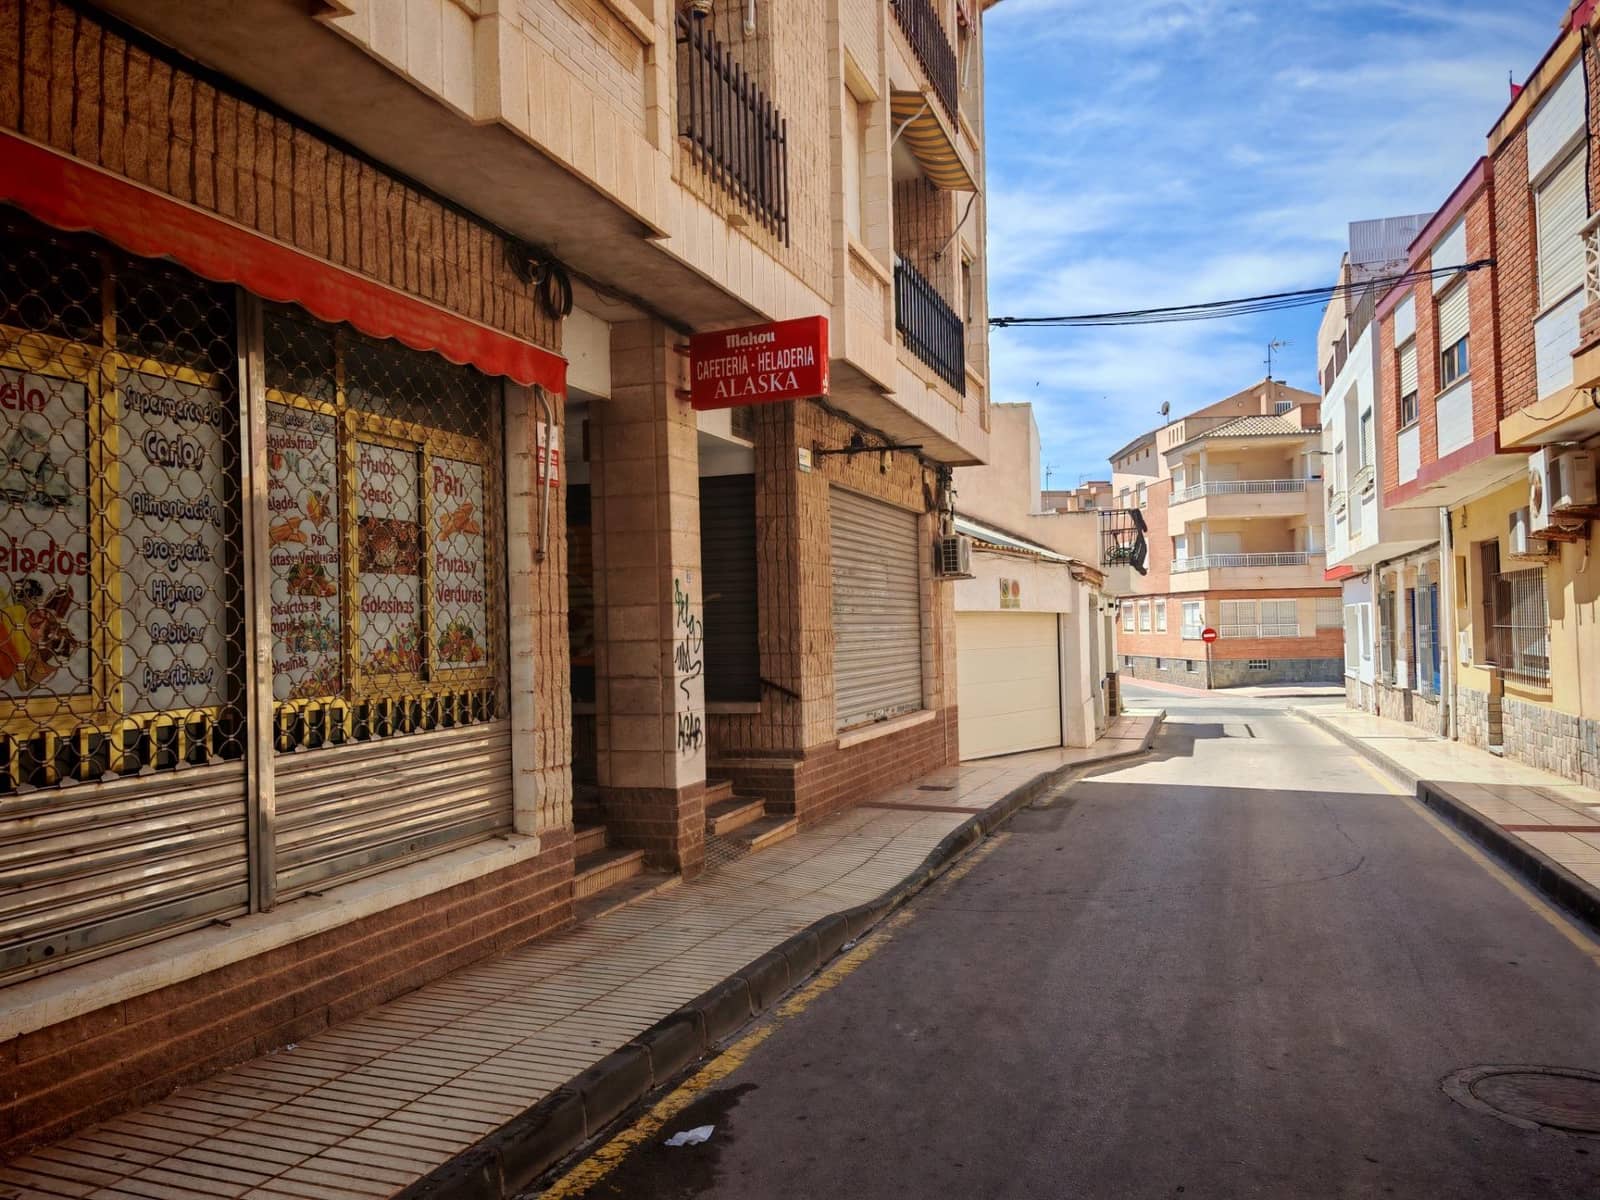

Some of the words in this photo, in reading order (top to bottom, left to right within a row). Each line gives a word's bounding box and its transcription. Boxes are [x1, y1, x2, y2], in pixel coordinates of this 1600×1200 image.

[726, 331, 776, 349] Mahou
[697, 355, 749, 381] CAFETERIA
[758, 345, 815, 373] HELADERIA
[714, 370, 799, 399] ALASKA
[124, 385, 220, 426] Supermercado
[144, 429, 205, 471] Carlos
[360, 452, 396, 476] Frutos
[361, 480, 393, 504] Secos
[432, 465, 463, 498] Pan
[131, 492, 220, 527] Alimentación
[436, 554, 467, 575] Frutas
[468, 560, 477, 578] y
[152, 580, 204, 613] Higiene
[361, 595, 415, 614] Golosinas
[436, 584, 484, 604] Verduras
[150, 622, 204, 644] Bebidas
